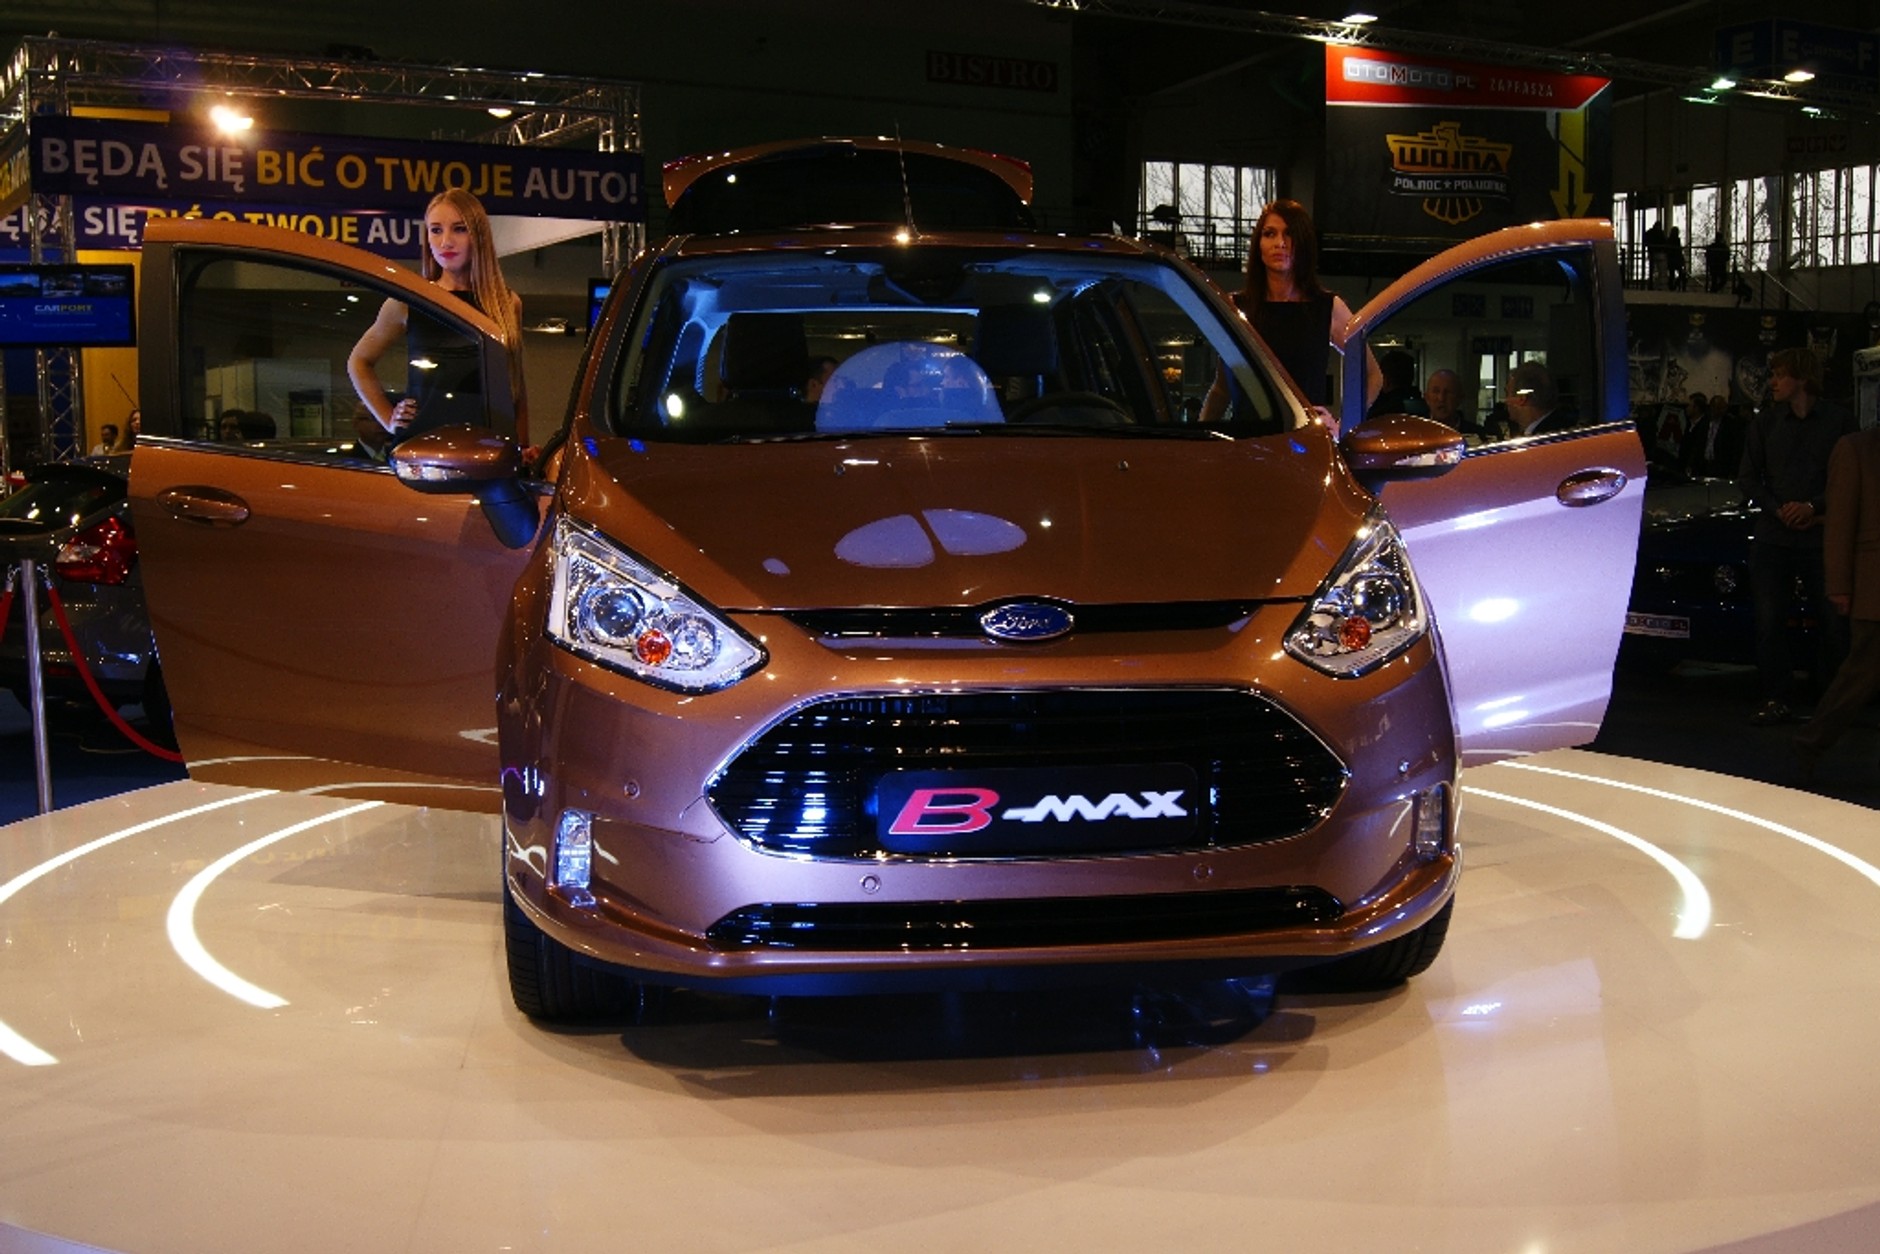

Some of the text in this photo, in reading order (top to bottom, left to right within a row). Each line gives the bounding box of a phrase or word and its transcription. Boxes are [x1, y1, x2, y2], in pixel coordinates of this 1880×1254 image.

[928, 53, 1053, 88] BISTRO
[41, 137, 168, 189] BĘDĄ
[179, 145, 244, 192] SIĘ
[256, 146, 325, 187] BIĆ
[335, 154, 368, 190] O
[375, 156, 514, 198] TWOJE
[523, 166, 639, 205] AUTO!
[84, 206, 138, 243] SIĘ
[367, 217, 426, 246] AUT
[34, 304, 93, 312] CARPORT
